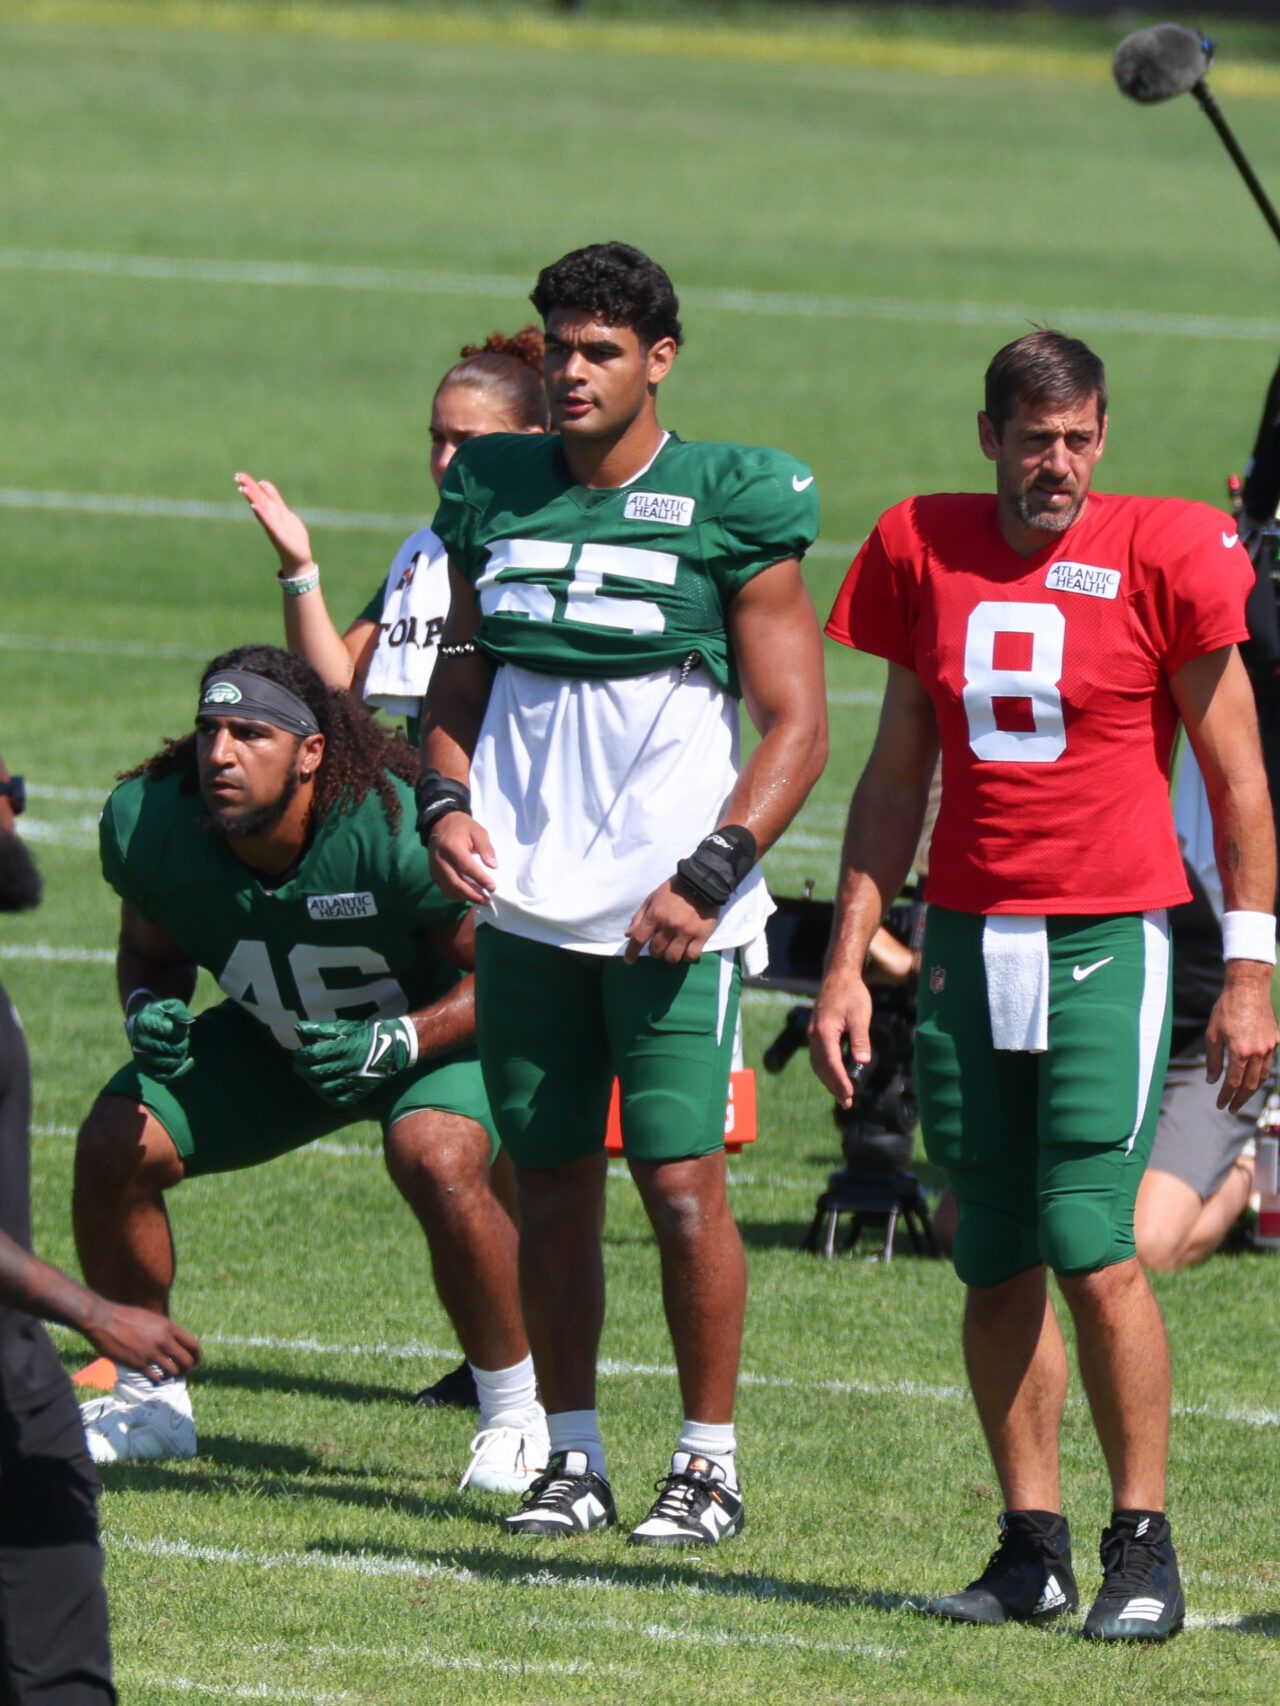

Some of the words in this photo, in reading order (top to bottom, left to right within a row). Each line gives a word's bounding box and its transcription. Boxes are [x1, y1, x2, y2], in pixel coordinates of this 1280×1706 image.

[629, 495, 690, 513] ATLANTIC
[633, 505, 681, 521] HEALTH
[1050, 565, 1116, 585] ATLANTIC
[1056, 576, 1106, 594] HEALTH
[962, 601, 1067, 762] 8
[310, 894, 372, 910] ATLANTIC
[320, 904, 367, 917] HEALTH
[218, 939, 409, 1050] 46
